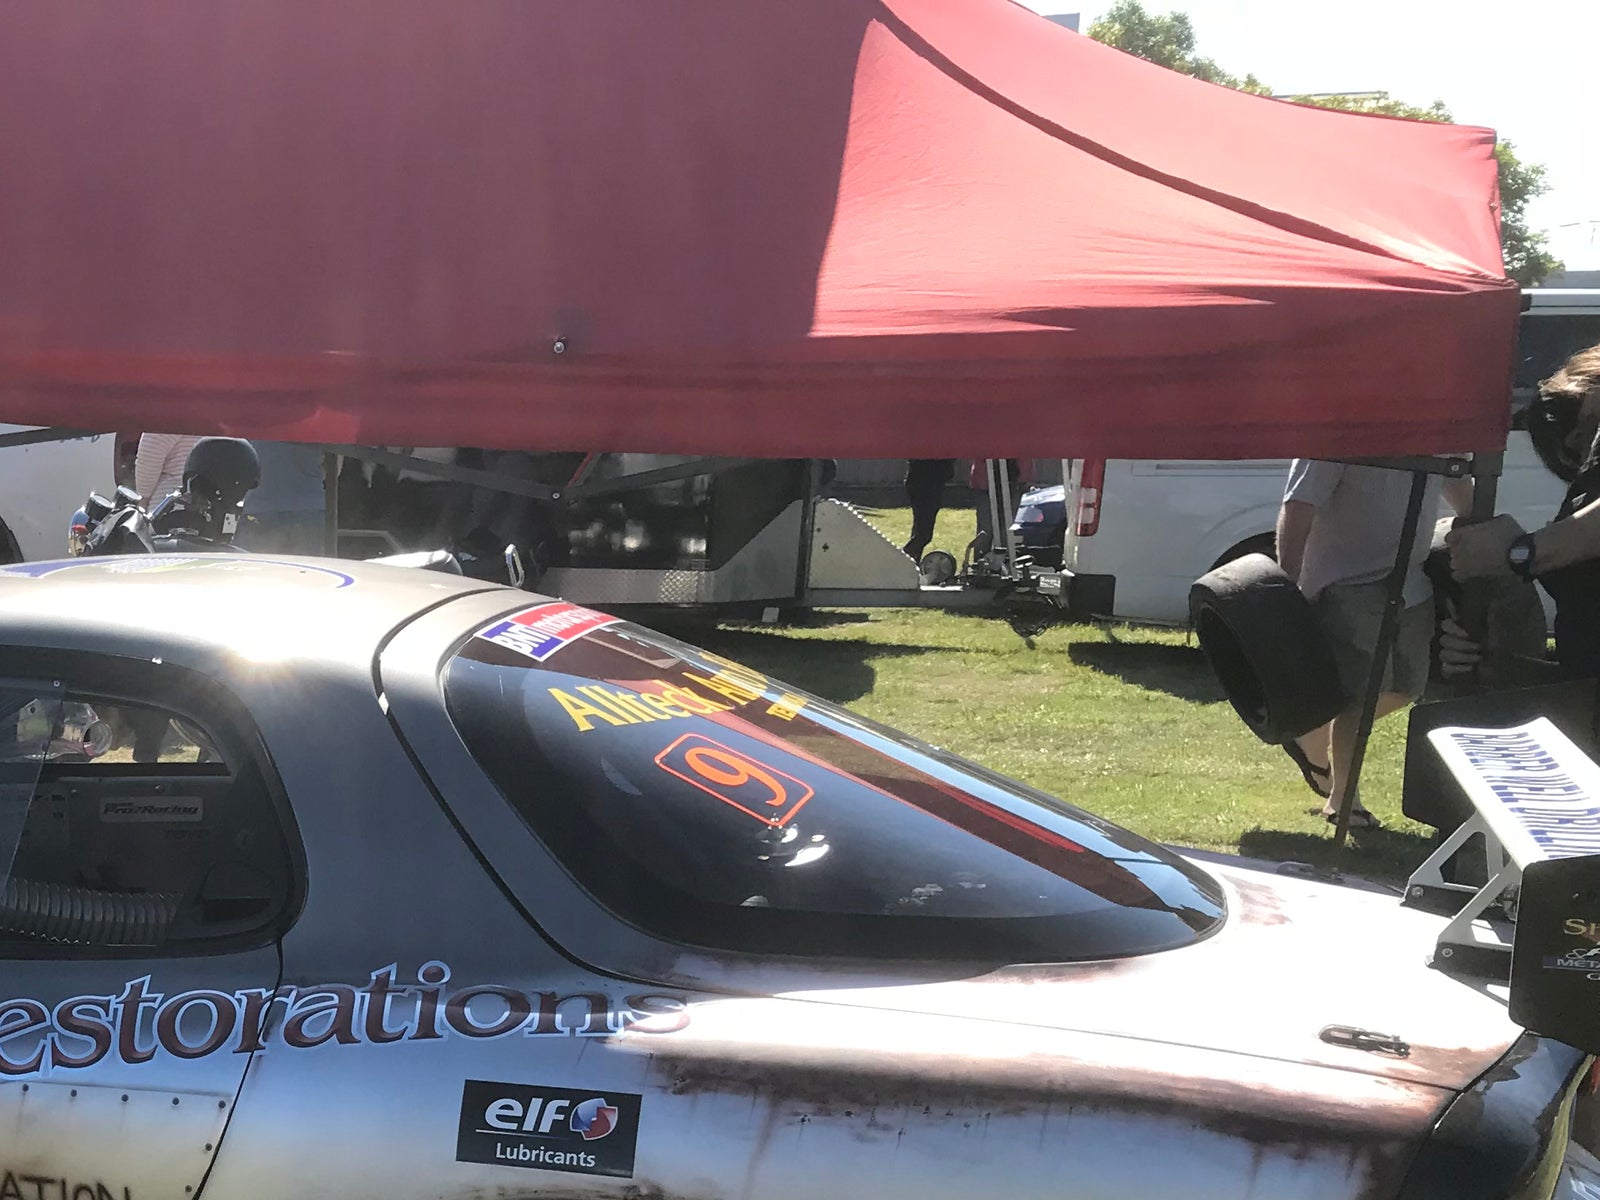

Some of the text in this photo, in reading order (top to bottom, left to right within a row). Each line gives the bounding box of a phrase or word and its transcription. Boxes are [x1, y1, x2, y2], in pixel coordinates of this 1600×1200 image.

[490, 623, 552, 655] BNT
[1450, 732, 1560, 771] BARBER
[685, 746, 787, 807] 9
[1482, 773, 1591, 804] WELL
[484, 1097, 570, 1133] elf
[495, 1142, 596, 1168] Lubricants
